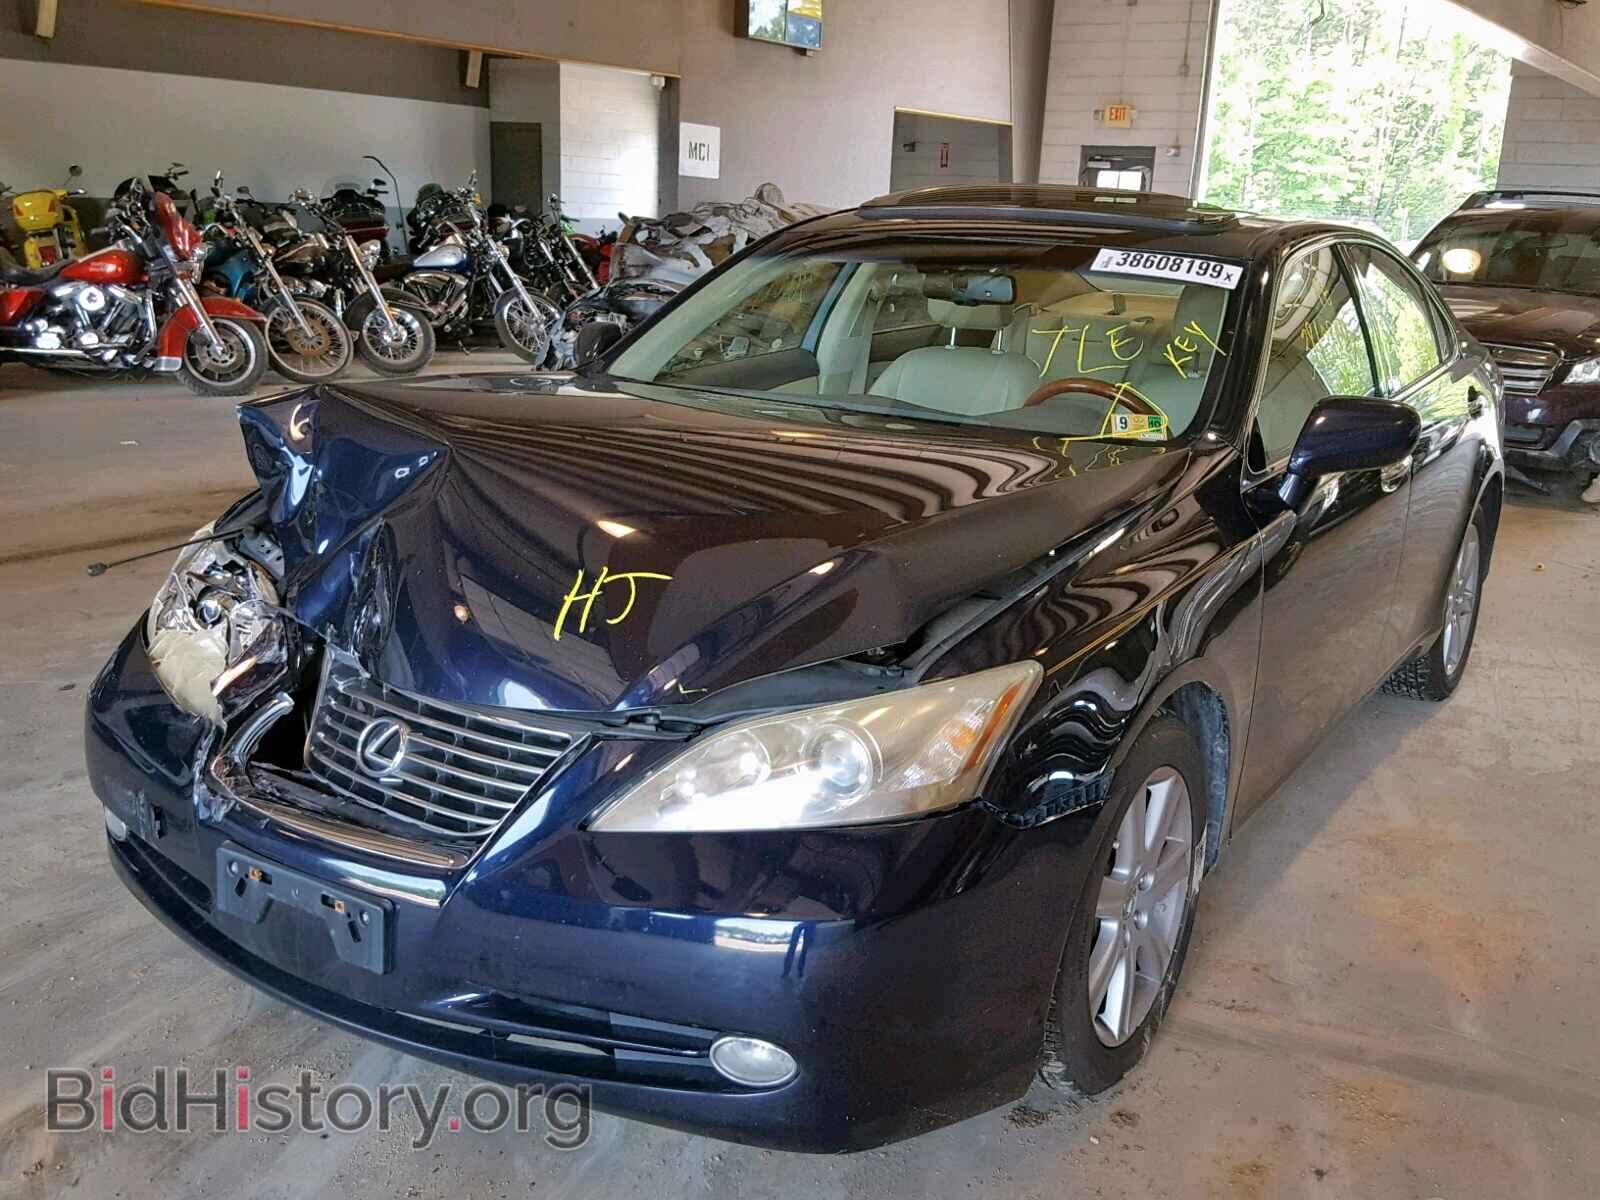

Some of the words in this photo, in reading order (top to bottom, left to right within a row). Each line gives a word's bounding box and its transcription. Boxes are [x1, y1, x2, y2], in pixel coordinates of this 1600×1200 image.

[1109, 106, 1126, 120] EXIT
[1116, 252, 1224, 279] 38608199
[1163, 321, 1227, 379] KEY
[1119, 416, 1128, 430] 9
